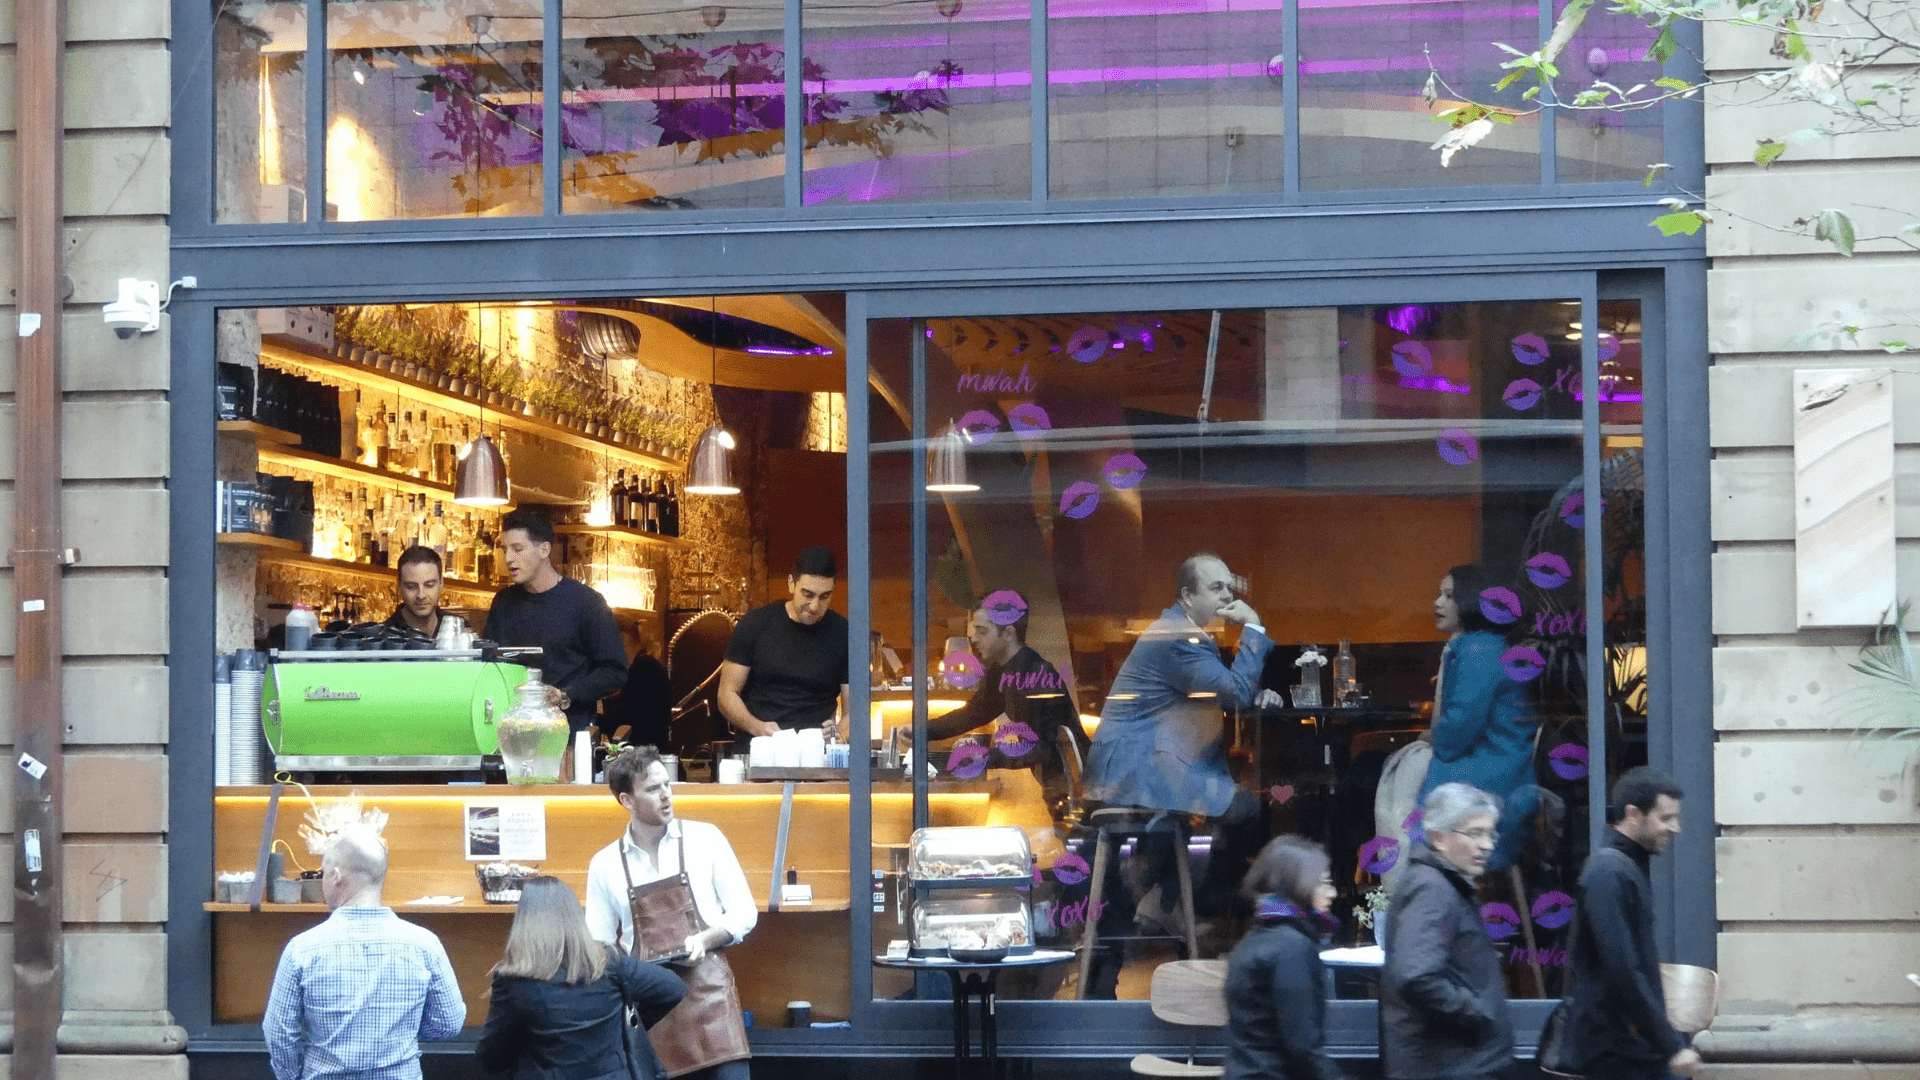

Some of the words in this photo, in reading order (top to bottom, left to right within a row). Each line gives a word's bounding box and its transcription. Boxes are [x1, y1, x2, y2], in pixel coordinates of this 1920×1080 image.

[957, 363, 1037, 393] mwah
[1549, 365, 1622, 394] xoo
[998, 660, 1079, 692] mwah
[1045, 895, 1109, 927] xoxo
[1510, 944, 1570, 968] mwa
